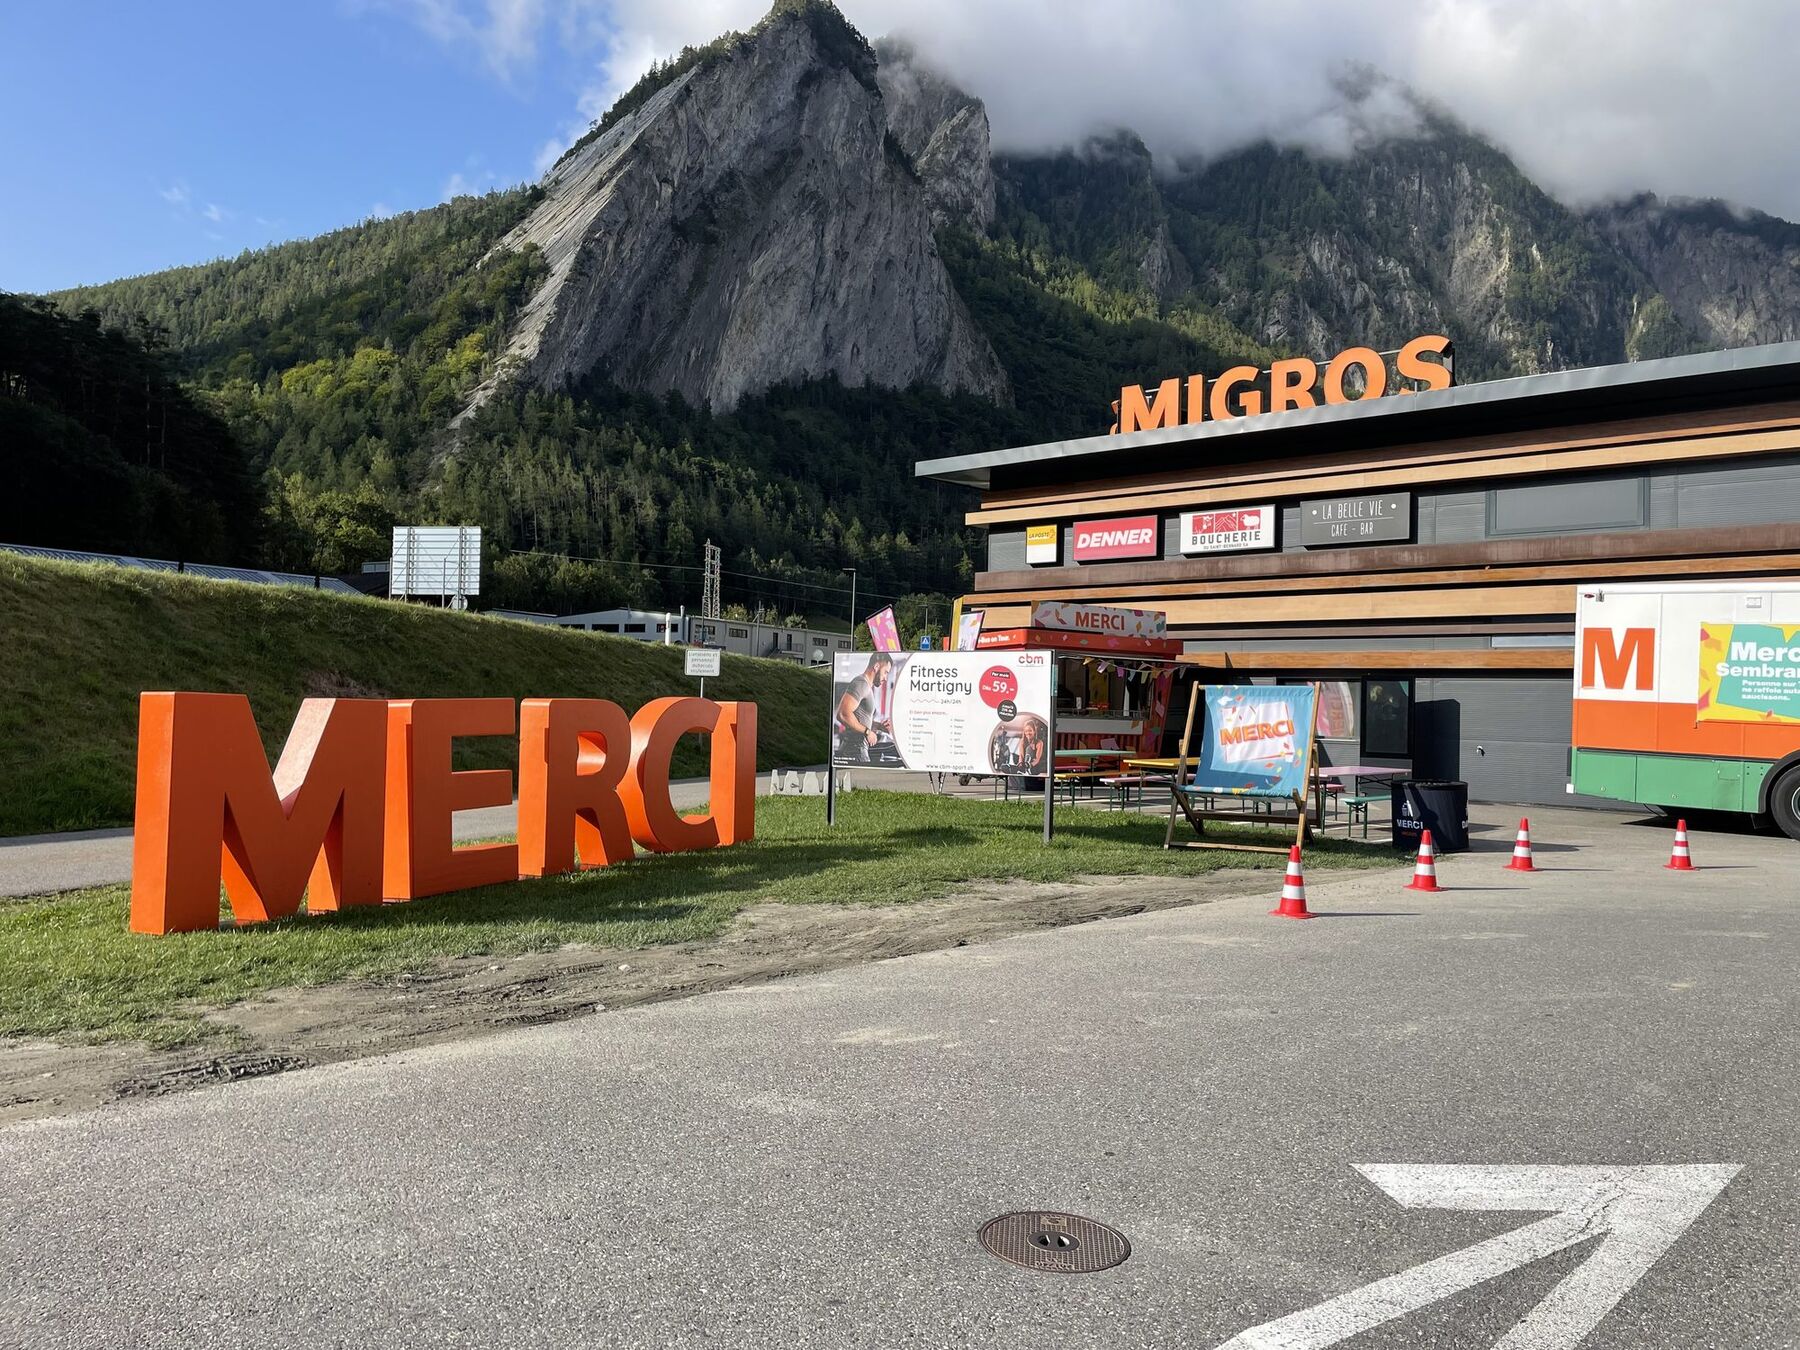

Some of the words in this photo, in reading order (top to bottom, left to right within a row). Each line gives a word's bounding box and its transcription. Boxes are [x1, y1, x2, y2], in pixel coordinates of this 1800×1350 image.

[1120, 334, 1452, 434] MIGROS
[1322, 504, 1332, 520] LA
[1337, 502, 1364, 519] BELLE
[1369, 500, 1384, 516] VIE
[1076, 528, 1153, 549] DENNER
[1191, 531, 1261, 546] BOUCHERIE
[1360, 522, 1374, 535] BAR
[1075, 612, 1125, 632] MERCI
[1018, 653, 1043, 665] cbm
[1582, 628, 1655, 690] M
[1731, 641, 1800, 663] Merc
[910, 665, 958, 679] Fitness
[910, 679, 972, 695] Martigny
[992, 680, 1015, 694] 59.-
[1220, 720, 1294, 745] MERCI
[129, 691, 757, 936] MERCI
